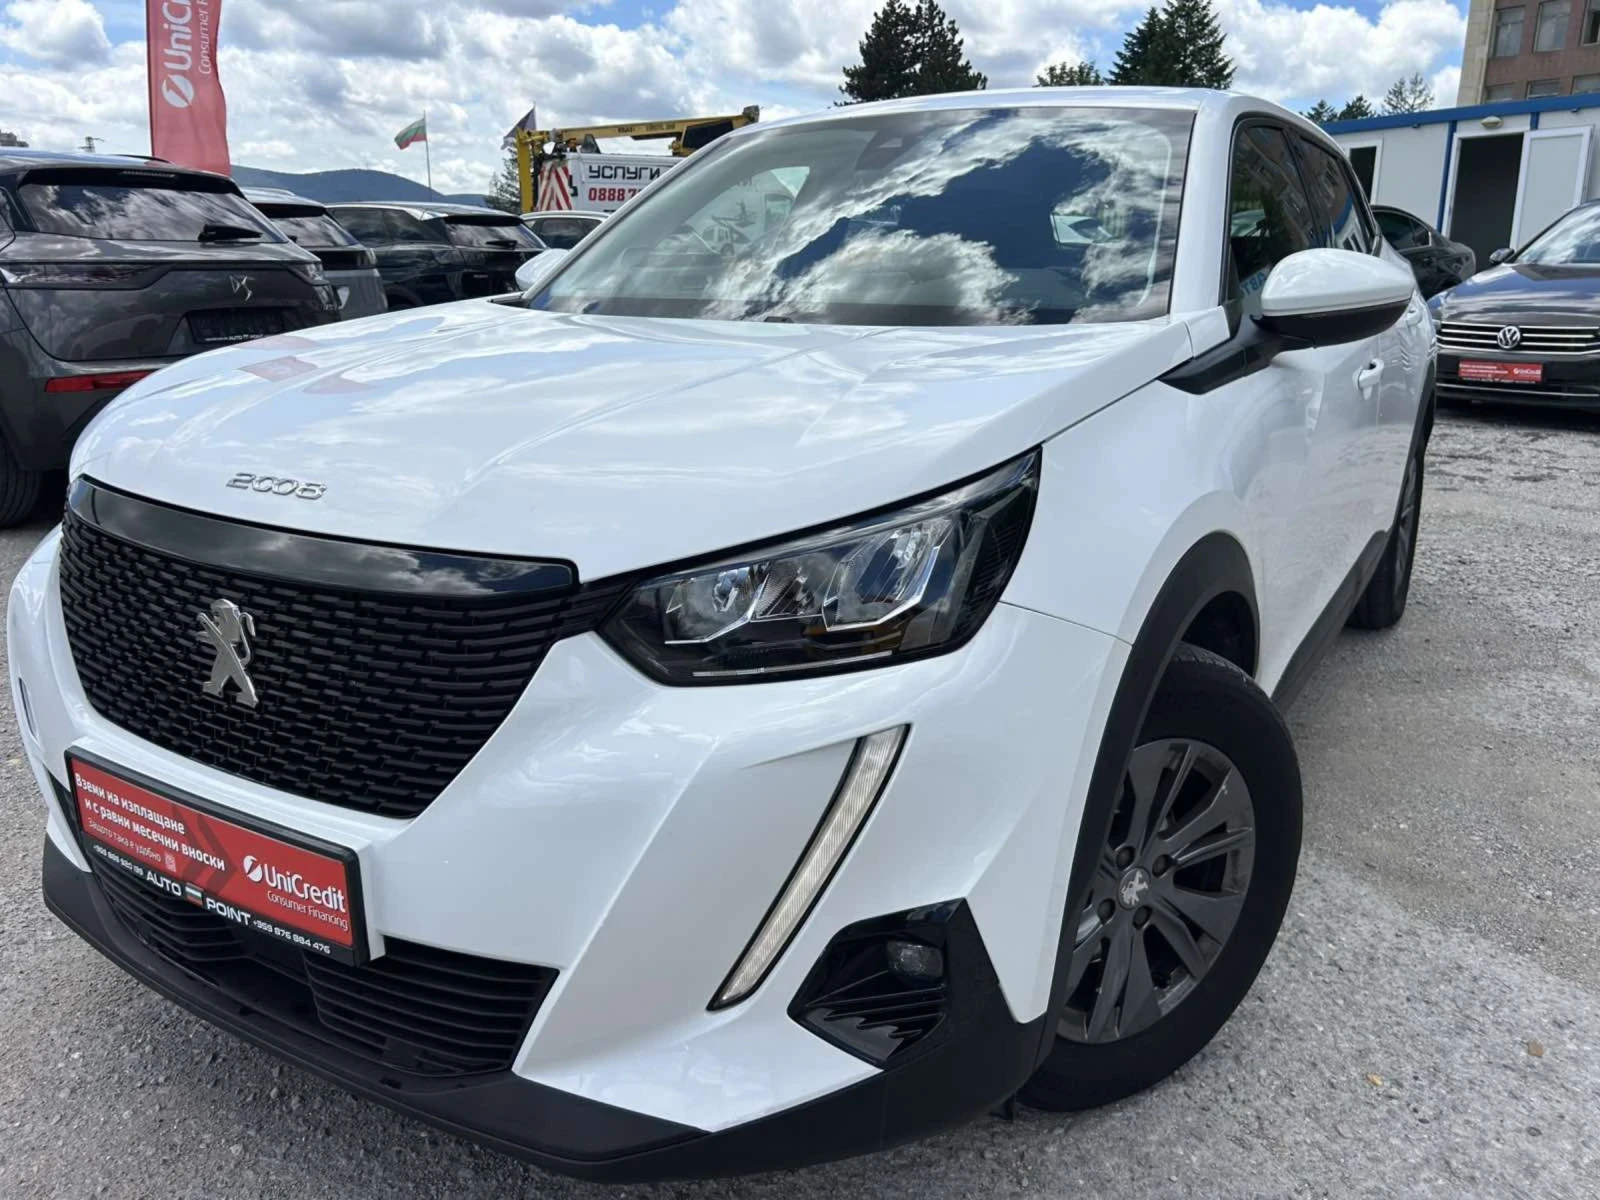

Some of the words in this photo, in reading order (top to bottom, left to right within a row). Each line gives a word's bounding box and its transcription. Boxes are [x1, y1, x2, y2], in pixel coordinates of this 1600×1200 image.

[197, 8, 212, 75] Consumer
[588, 187, 626, 202] 0888
[226, 473, 327, 500] 2008
[75, 773, 105, 799] Вземи
[107, 790, 120, 806] на
[121, 797, 185, 835] изплащане
[84, 798, 92, 810] и
[92, 803, 99, 813] с
[100, 806, 131, 830] равни
[132, 821, 179, 852] месечни
[181, 843, 226, 872] вноски
[146, 870, 181, 896] AUTO
[205, 897, 251, 926] POINT
[253, 920, 273, 933] +359
[274, 927, 291, 940] 876
[312, 942, 330, 954] 476
[264, 863, 346, 913] UniCredit
[267, 890, 306, 914] Consumer
[308, 904, 348, 932] Financing
